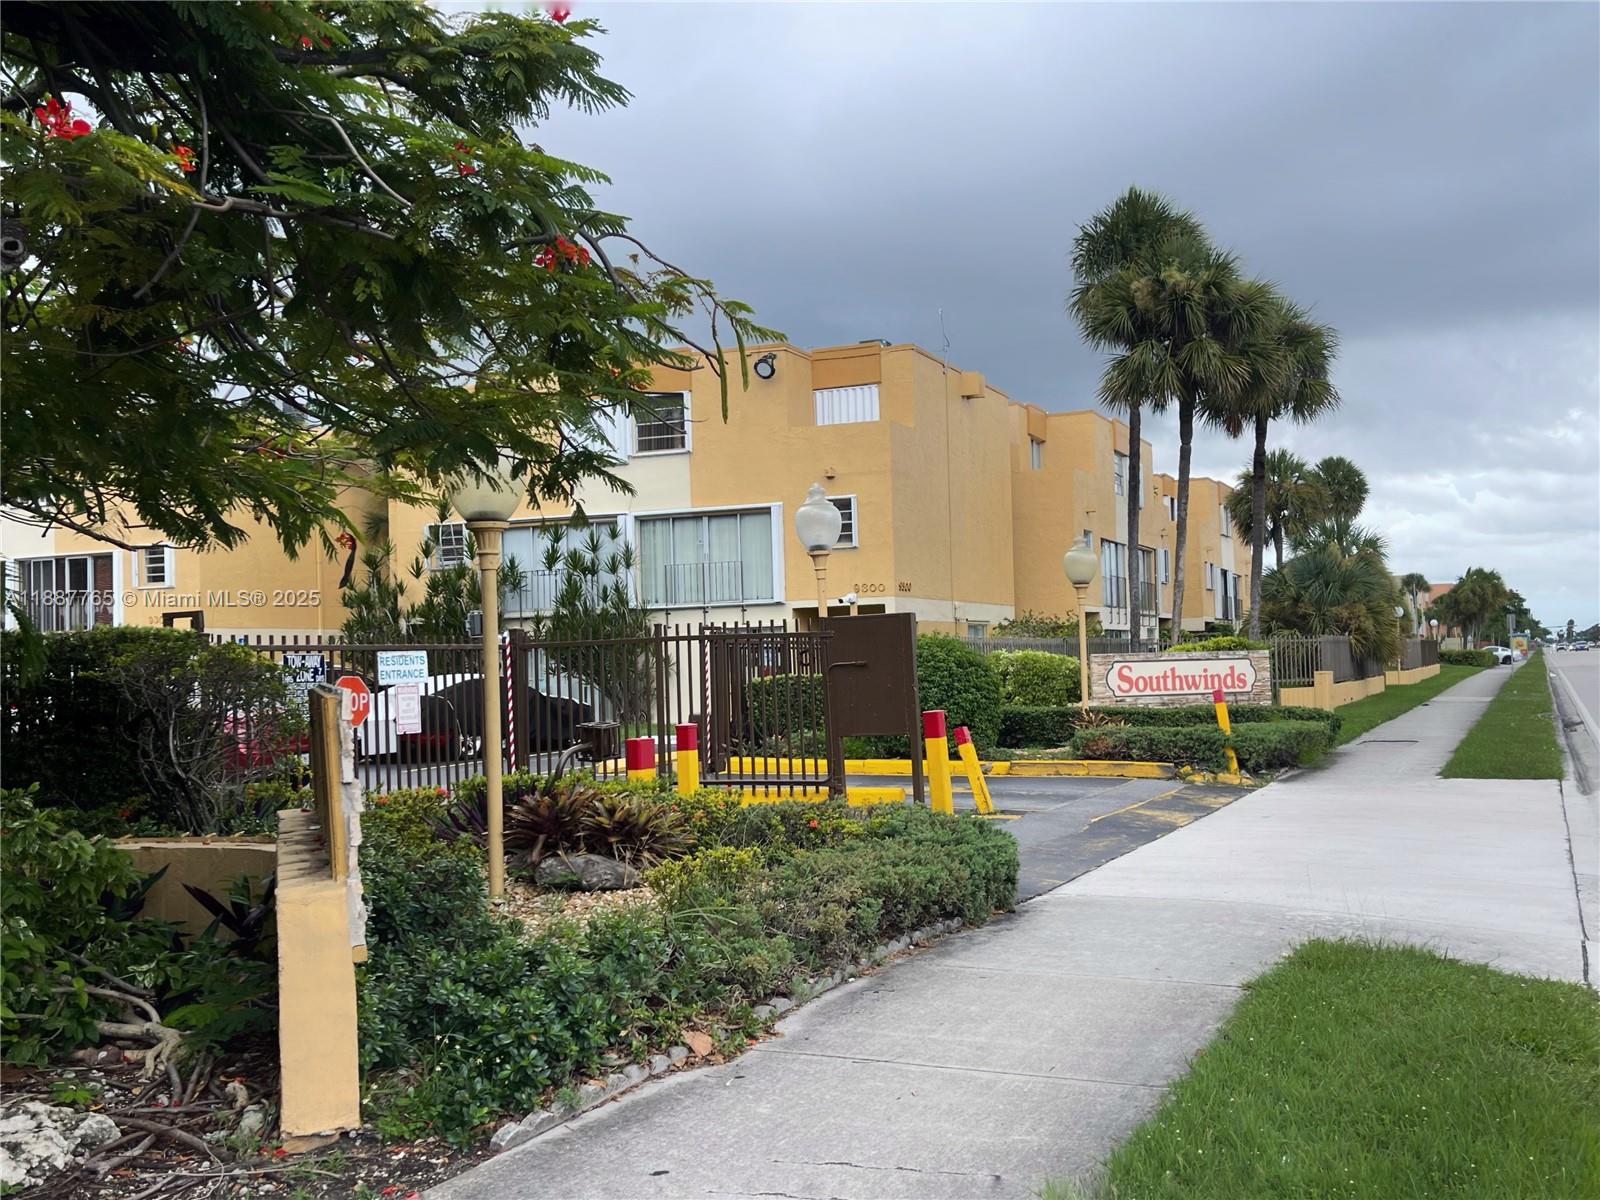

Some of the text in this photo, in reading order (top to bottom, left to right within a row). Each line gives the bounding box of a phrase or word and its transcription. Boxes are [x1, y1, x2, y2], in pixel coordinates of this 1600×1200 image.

[380, 655, 426, 667] RESIDENTS
[380, 669, 425, 680] ENTRANCE
[1117, 664, 1247, 693] Southwinds
[351, 692, 368, 711] OP
